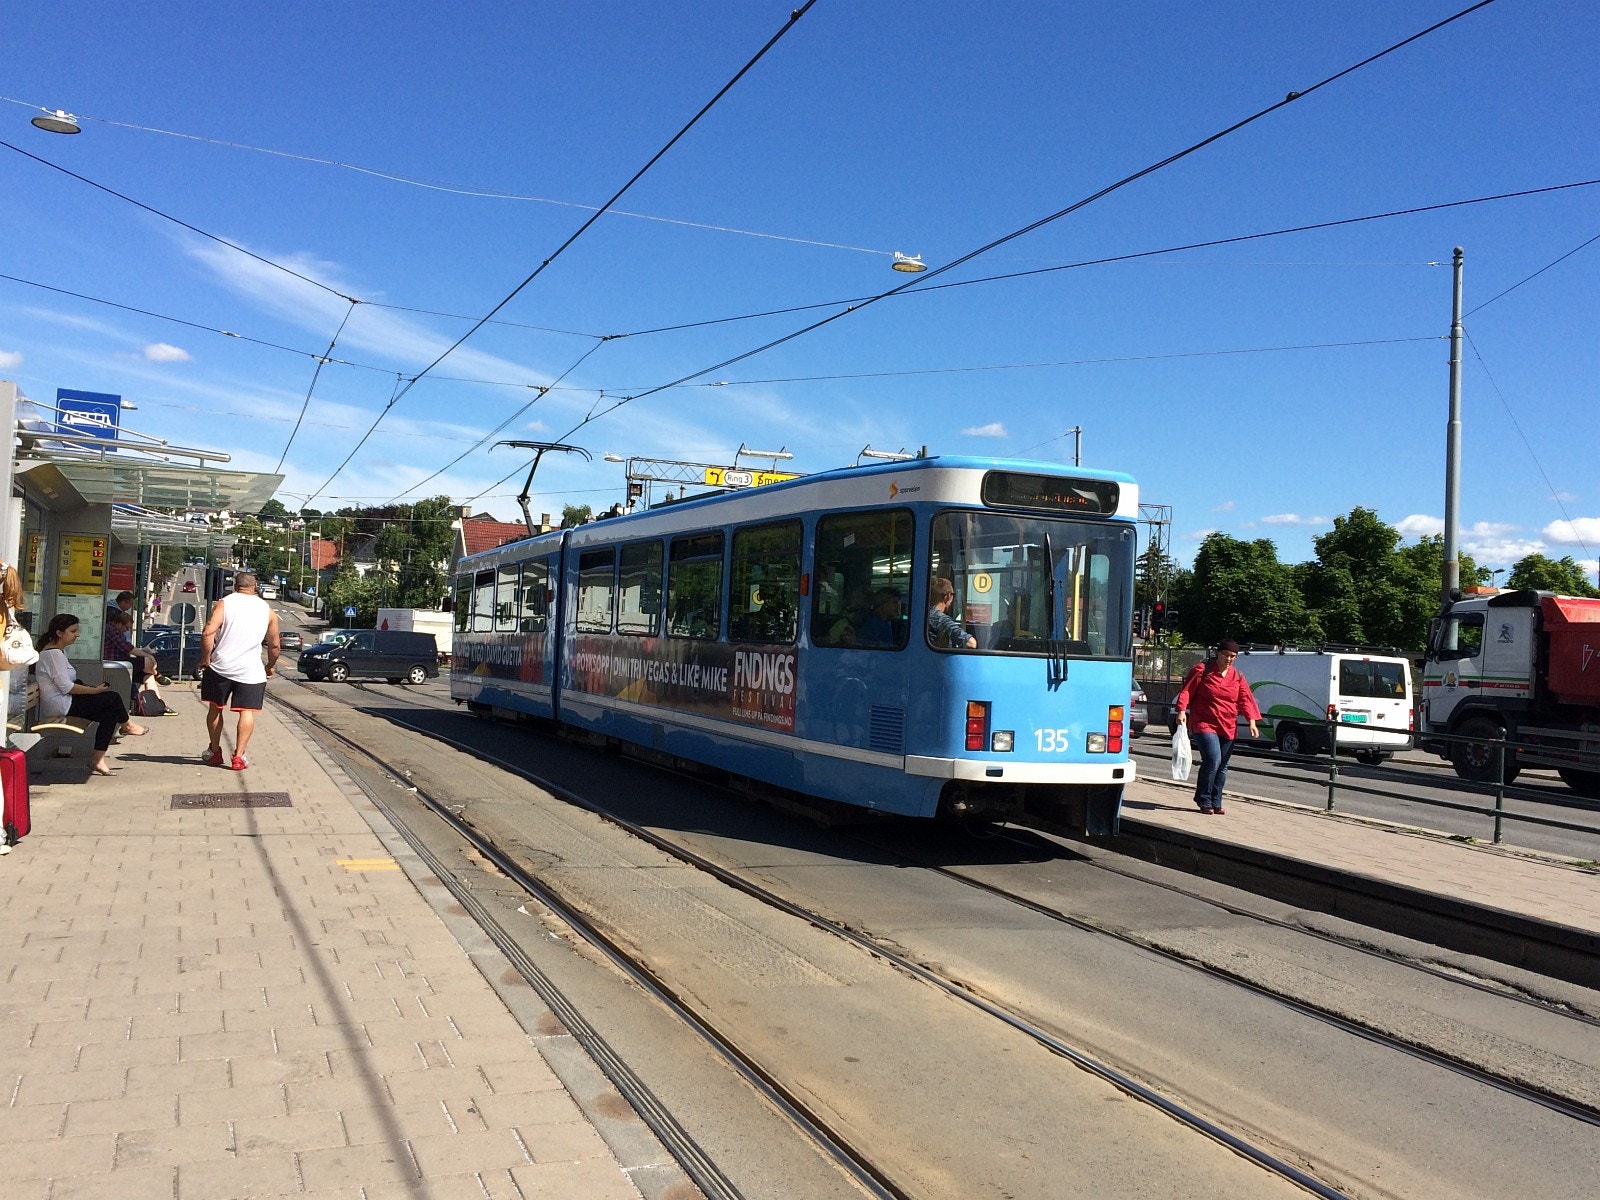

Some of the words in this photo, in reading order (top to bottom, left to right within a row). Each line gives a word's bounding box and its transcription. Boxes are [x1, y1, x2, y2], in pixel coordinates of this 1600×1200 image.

[727, 474, 743, 484] Ring
[744, 475, 749, 483] 3
[978, 576, 988, 588] D
[502, 645, 523, 667] GUETTA
[613, 657, 642, 680] DIMITRI
[643, 659, 670, 684] VEGAS
[671, 662, 678, 685] &
[679, 663, 700, 688] LIKE
[701, 665, 728, 693] MIKE
[734, 651, 795, 695] FNDNGS
[733, 689, 793, 710] FESTIVAL
[1034, 728, 1069, 753] 135
